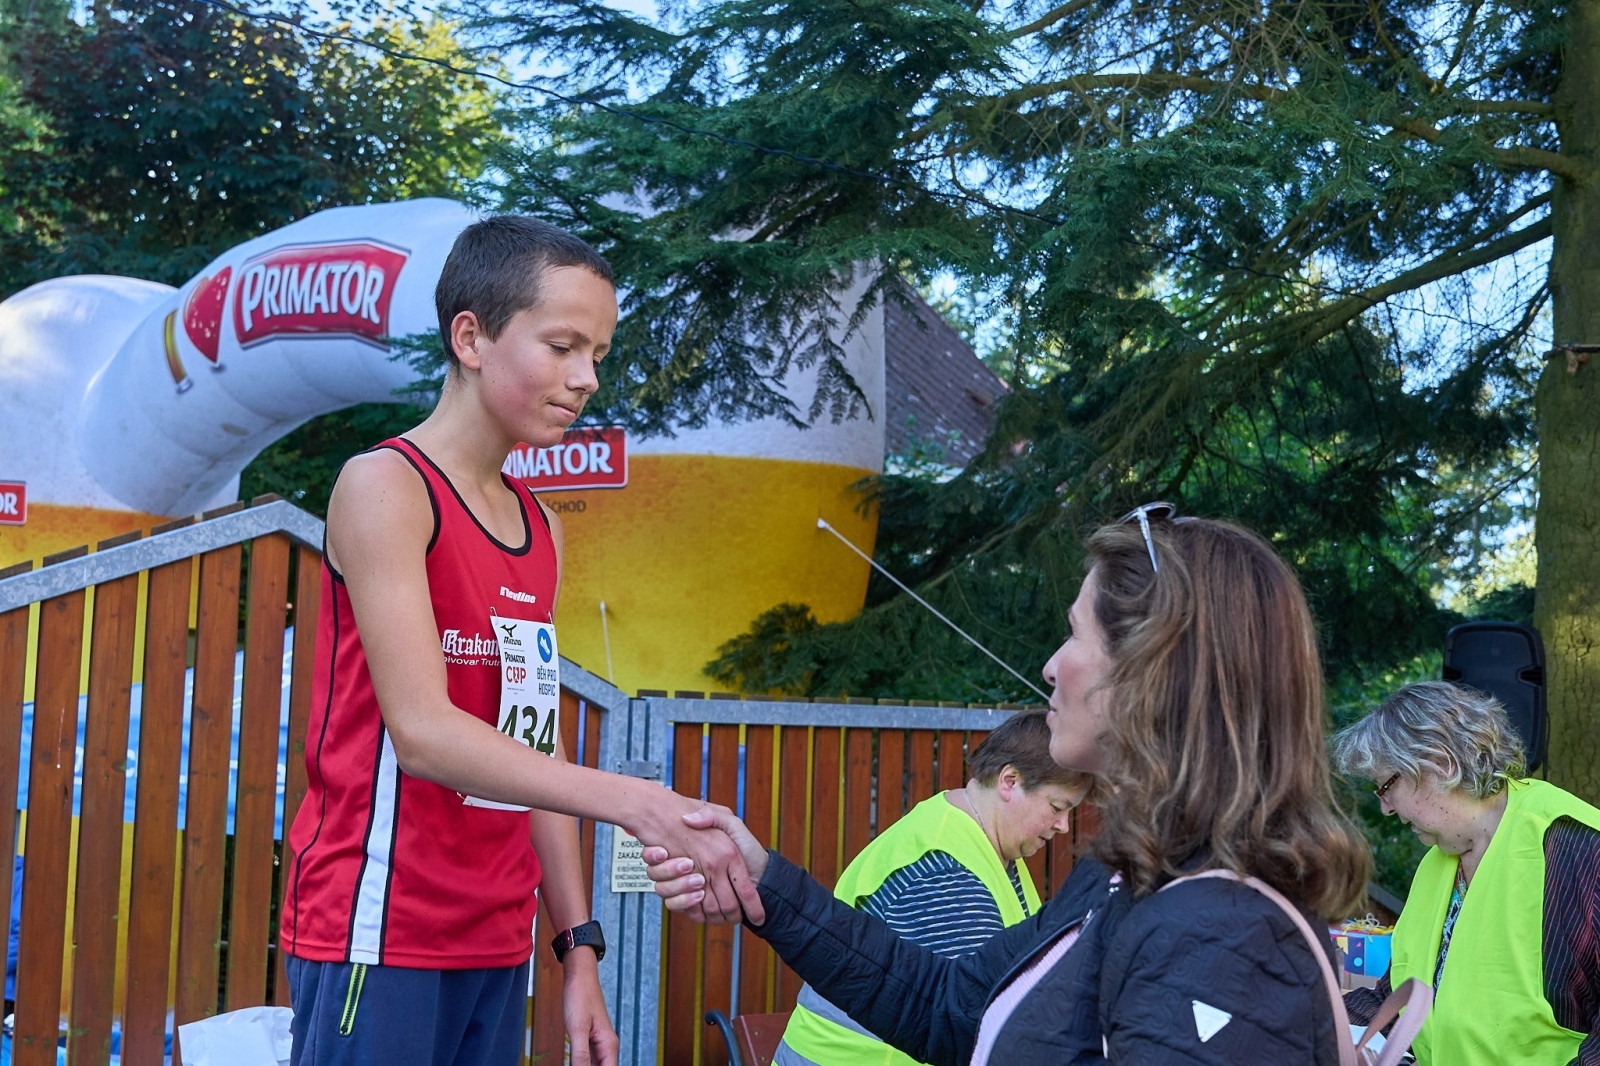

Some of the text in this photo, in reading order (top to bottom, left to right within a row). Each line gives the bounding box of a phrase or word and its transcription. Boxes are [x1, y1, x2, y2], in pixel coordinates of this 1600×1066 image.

[241, 261, 385, 332] PRIMATOR
[506, 665, 527, 684] CUP
[547, 668, 557, 682] PRO
[538, 682, 556, 697] HOSPIC
